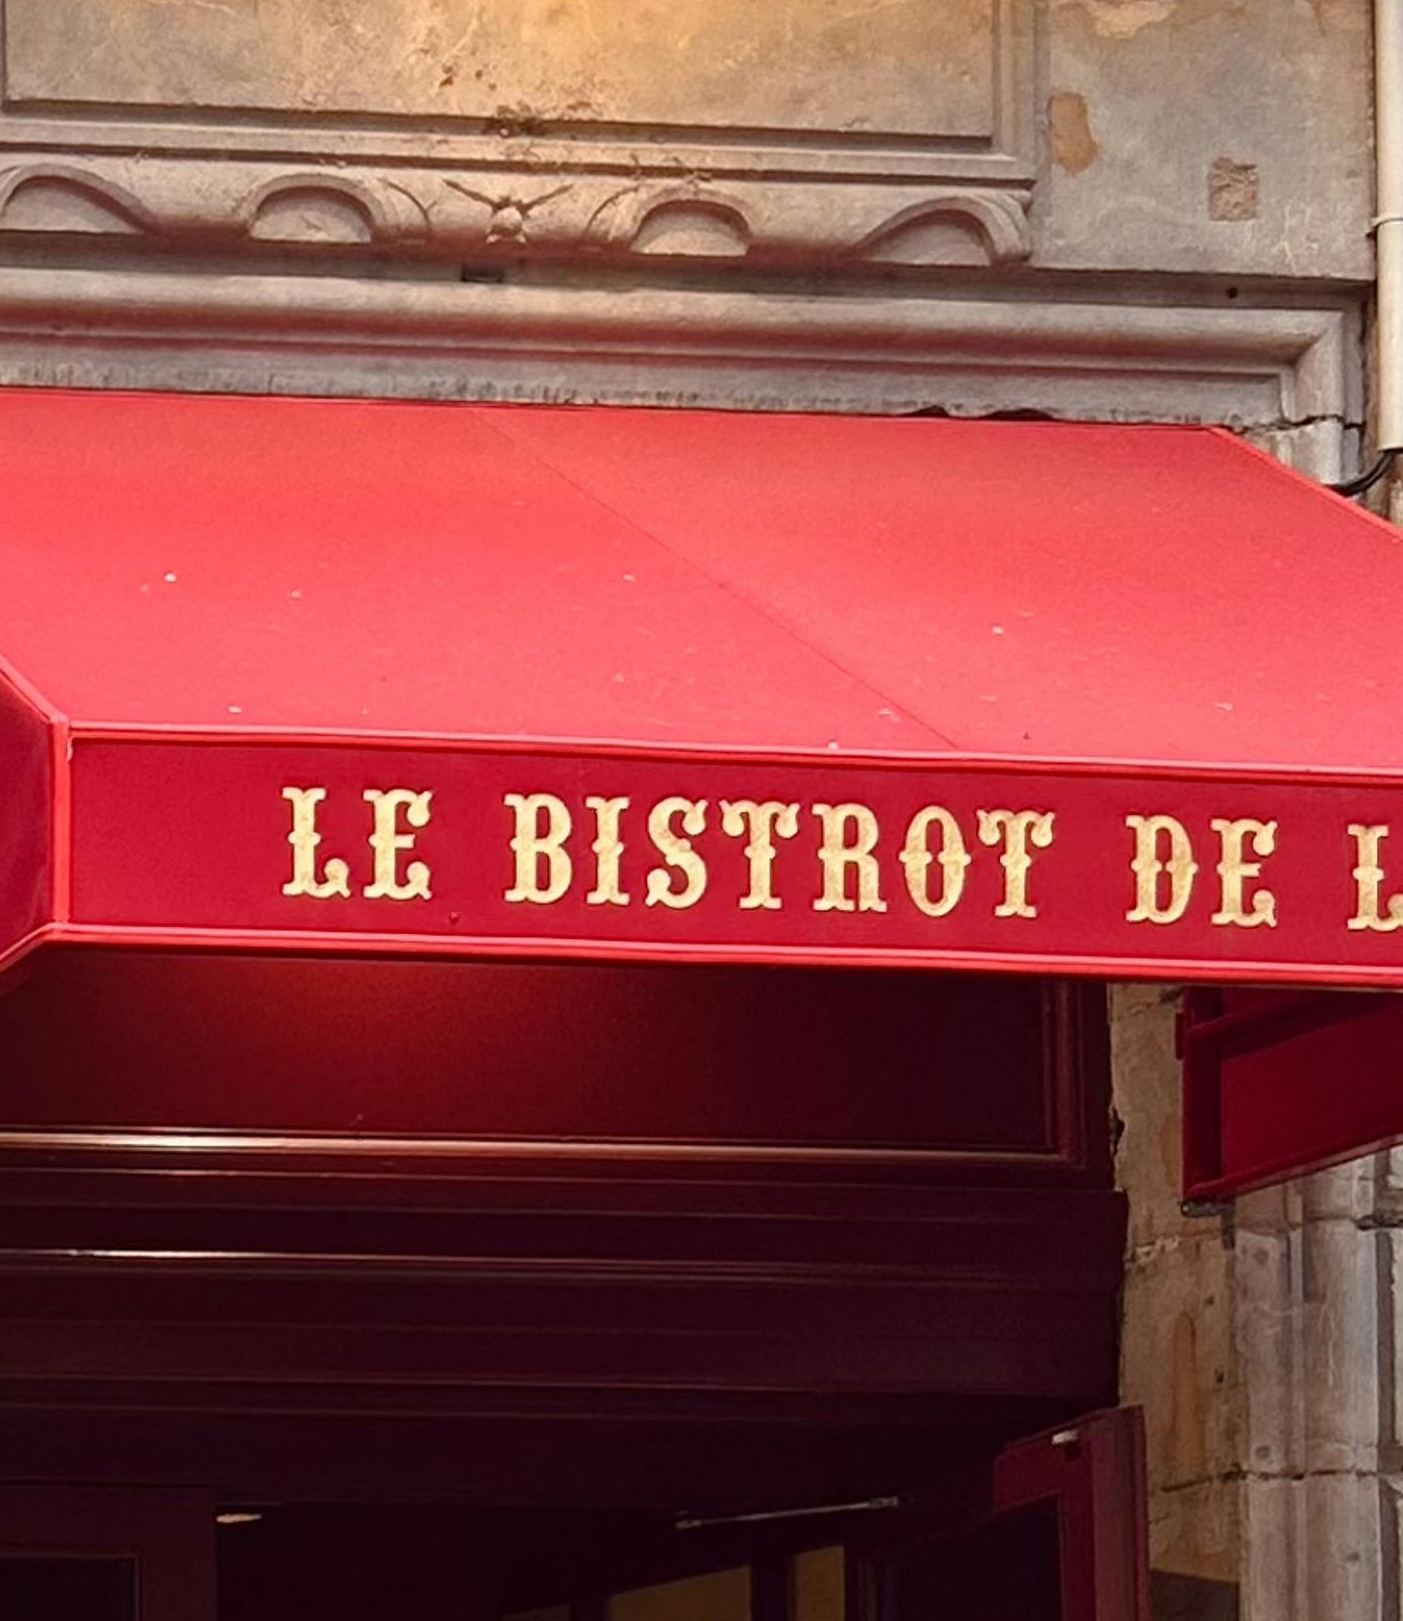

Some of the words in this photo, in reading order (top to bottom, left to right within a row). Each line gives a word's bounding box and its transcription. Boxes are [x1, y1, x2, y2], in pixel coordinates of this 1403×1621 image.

[282, 786, 432, 901] LE
[504, 792, 1055, 919] BISTROT
[1126, 815, 1277, 928] DE
